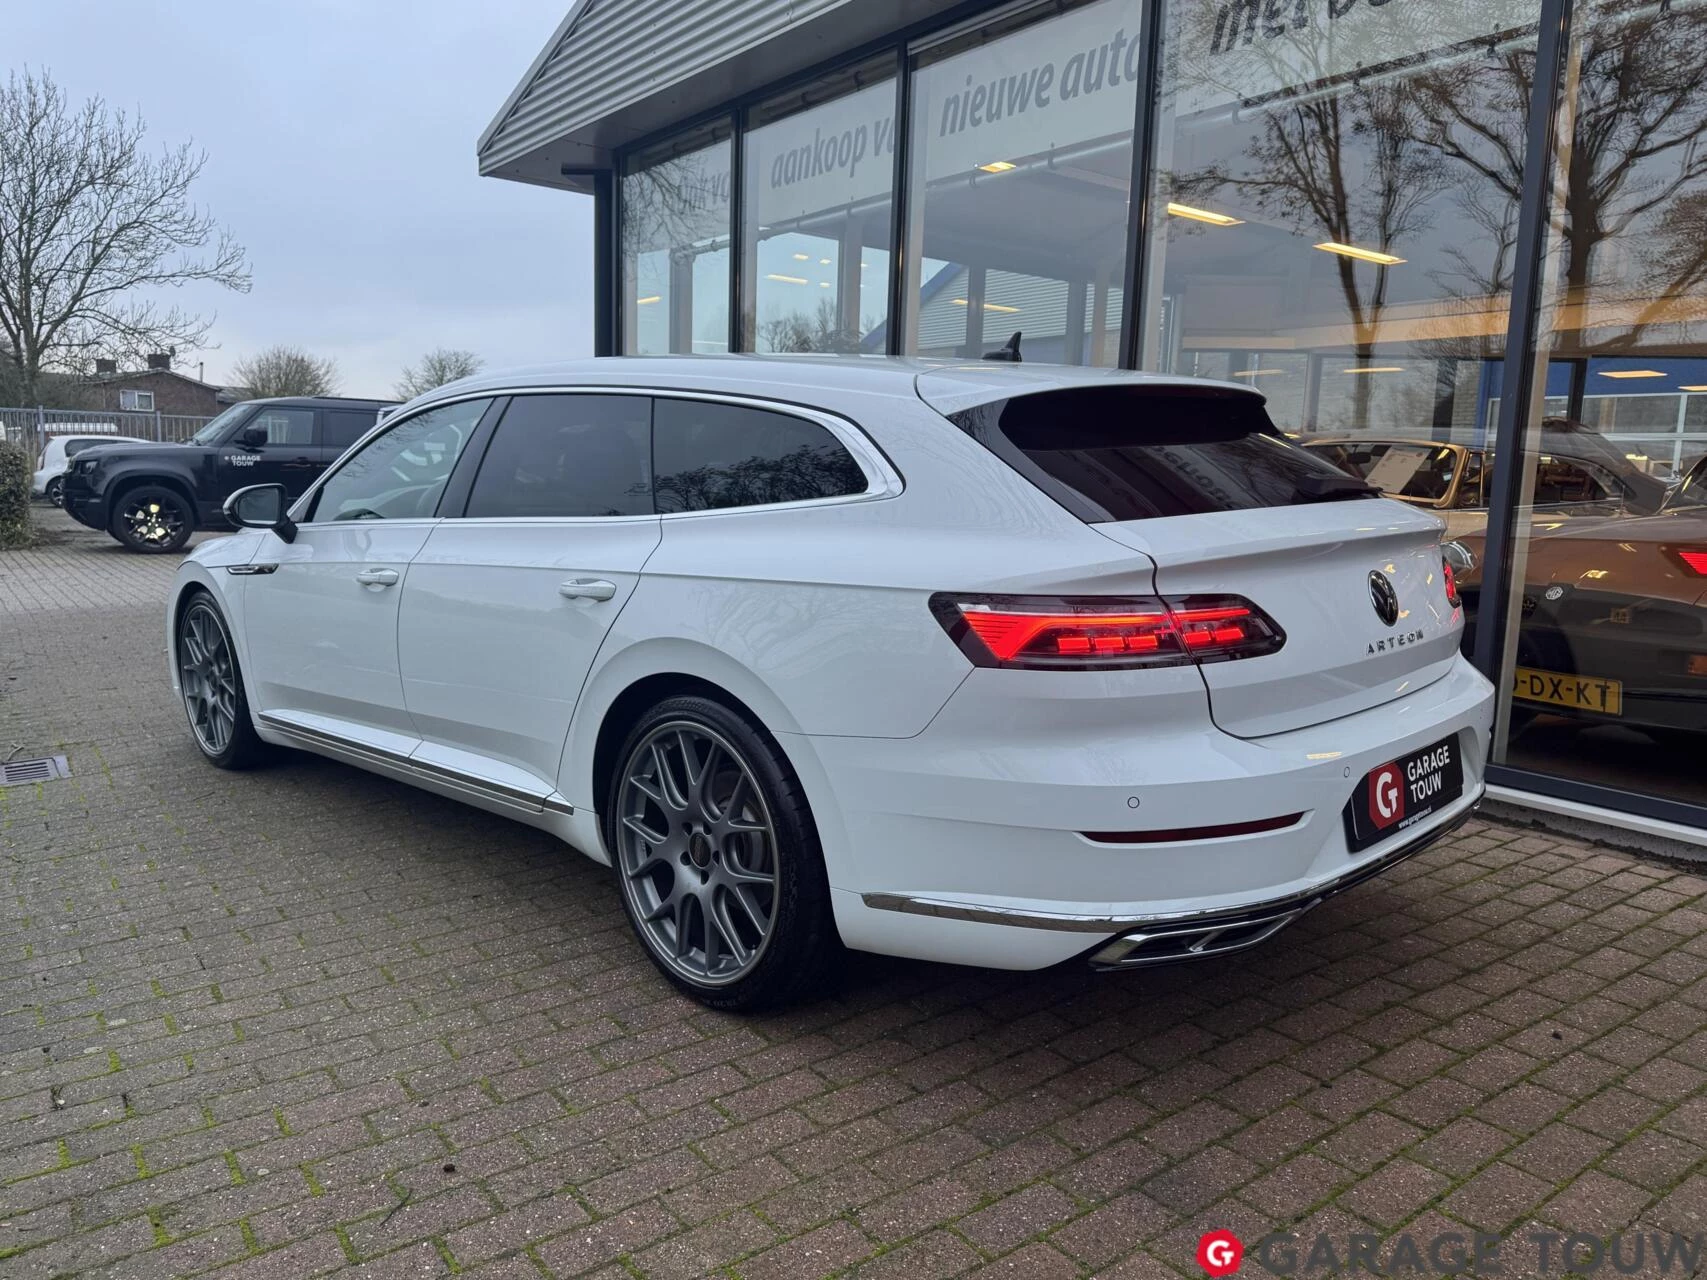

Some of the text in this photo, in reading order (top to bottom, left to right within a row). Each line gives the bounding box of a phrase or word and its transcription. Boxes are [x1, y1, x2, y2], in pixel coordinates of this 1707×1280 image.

[939, 61, 1055, 137] nieuwe
[771, 124, 867, 189] aankoop
[1366, 630, 1424, 655] ARTEON
[1407, 745, 1450, 781] GARAGE
[1410, 771, 1442, 803] TOUW
